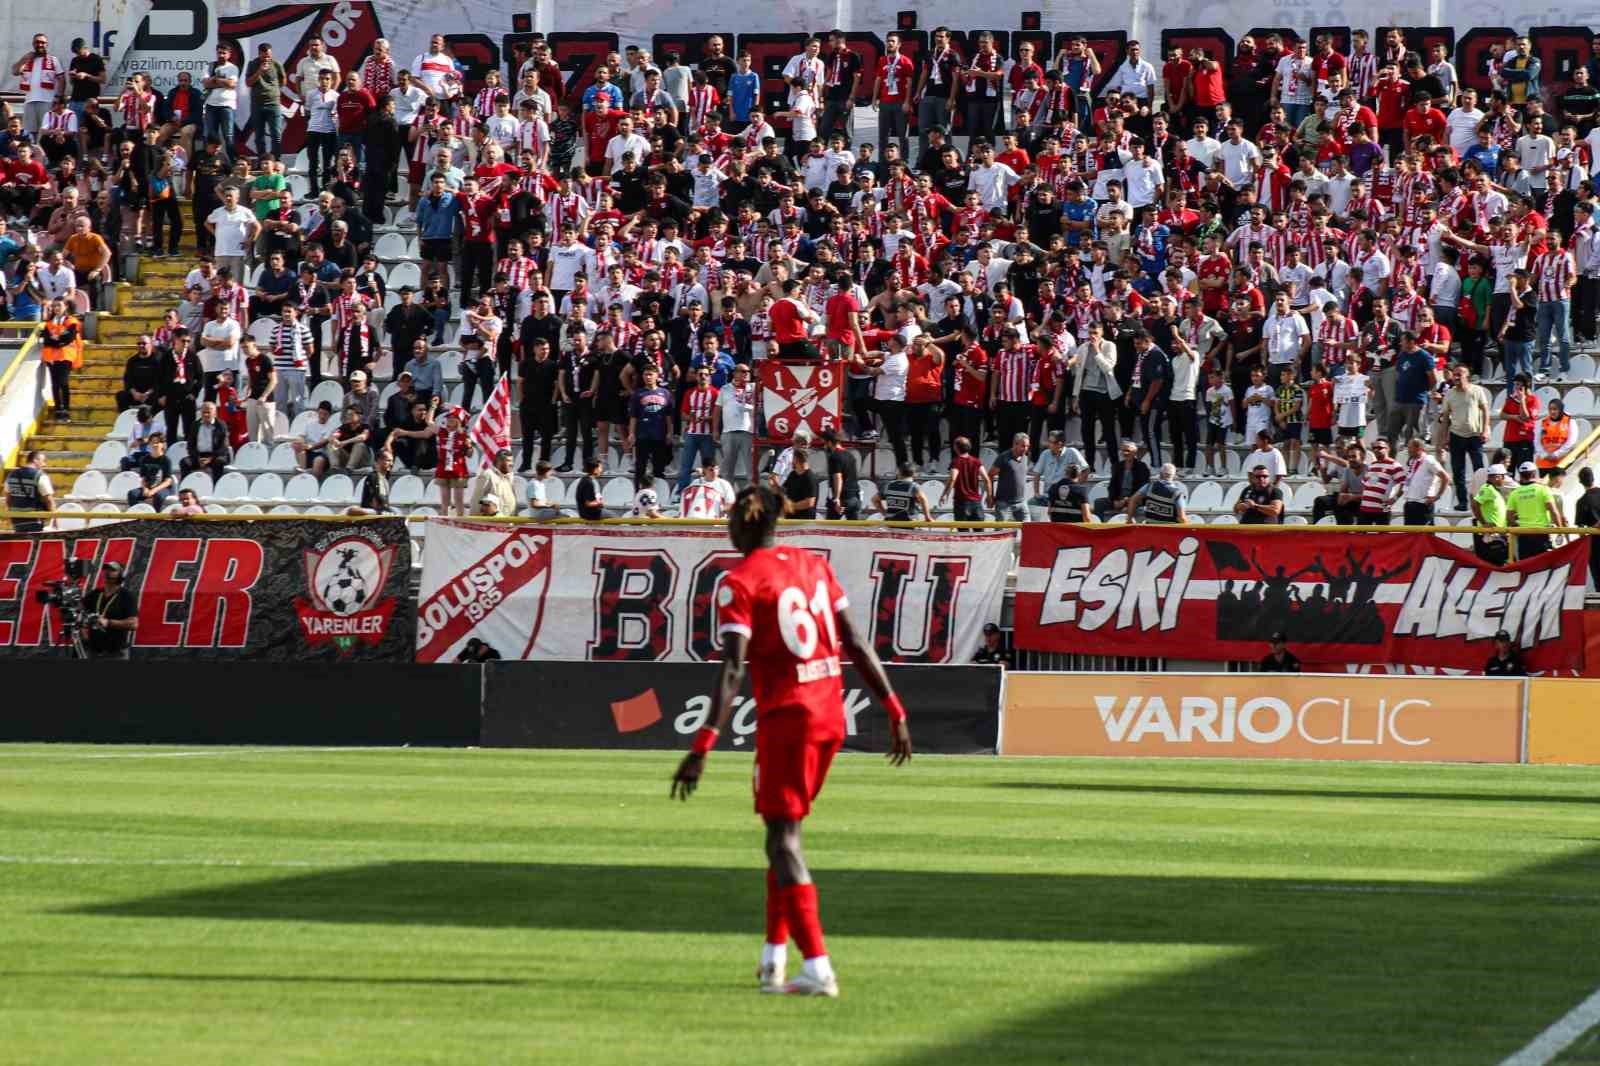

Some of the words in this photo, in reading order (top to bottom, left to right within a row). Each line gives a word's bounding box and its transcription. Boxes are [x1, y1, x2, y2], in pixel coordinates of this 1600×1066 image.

[301, 615, 383, 635] YARENLER
[464, 585, 503, 623] 1965
[777, 579, 838, 659] 61
[1392, 555, 1572, 648] ALEM
